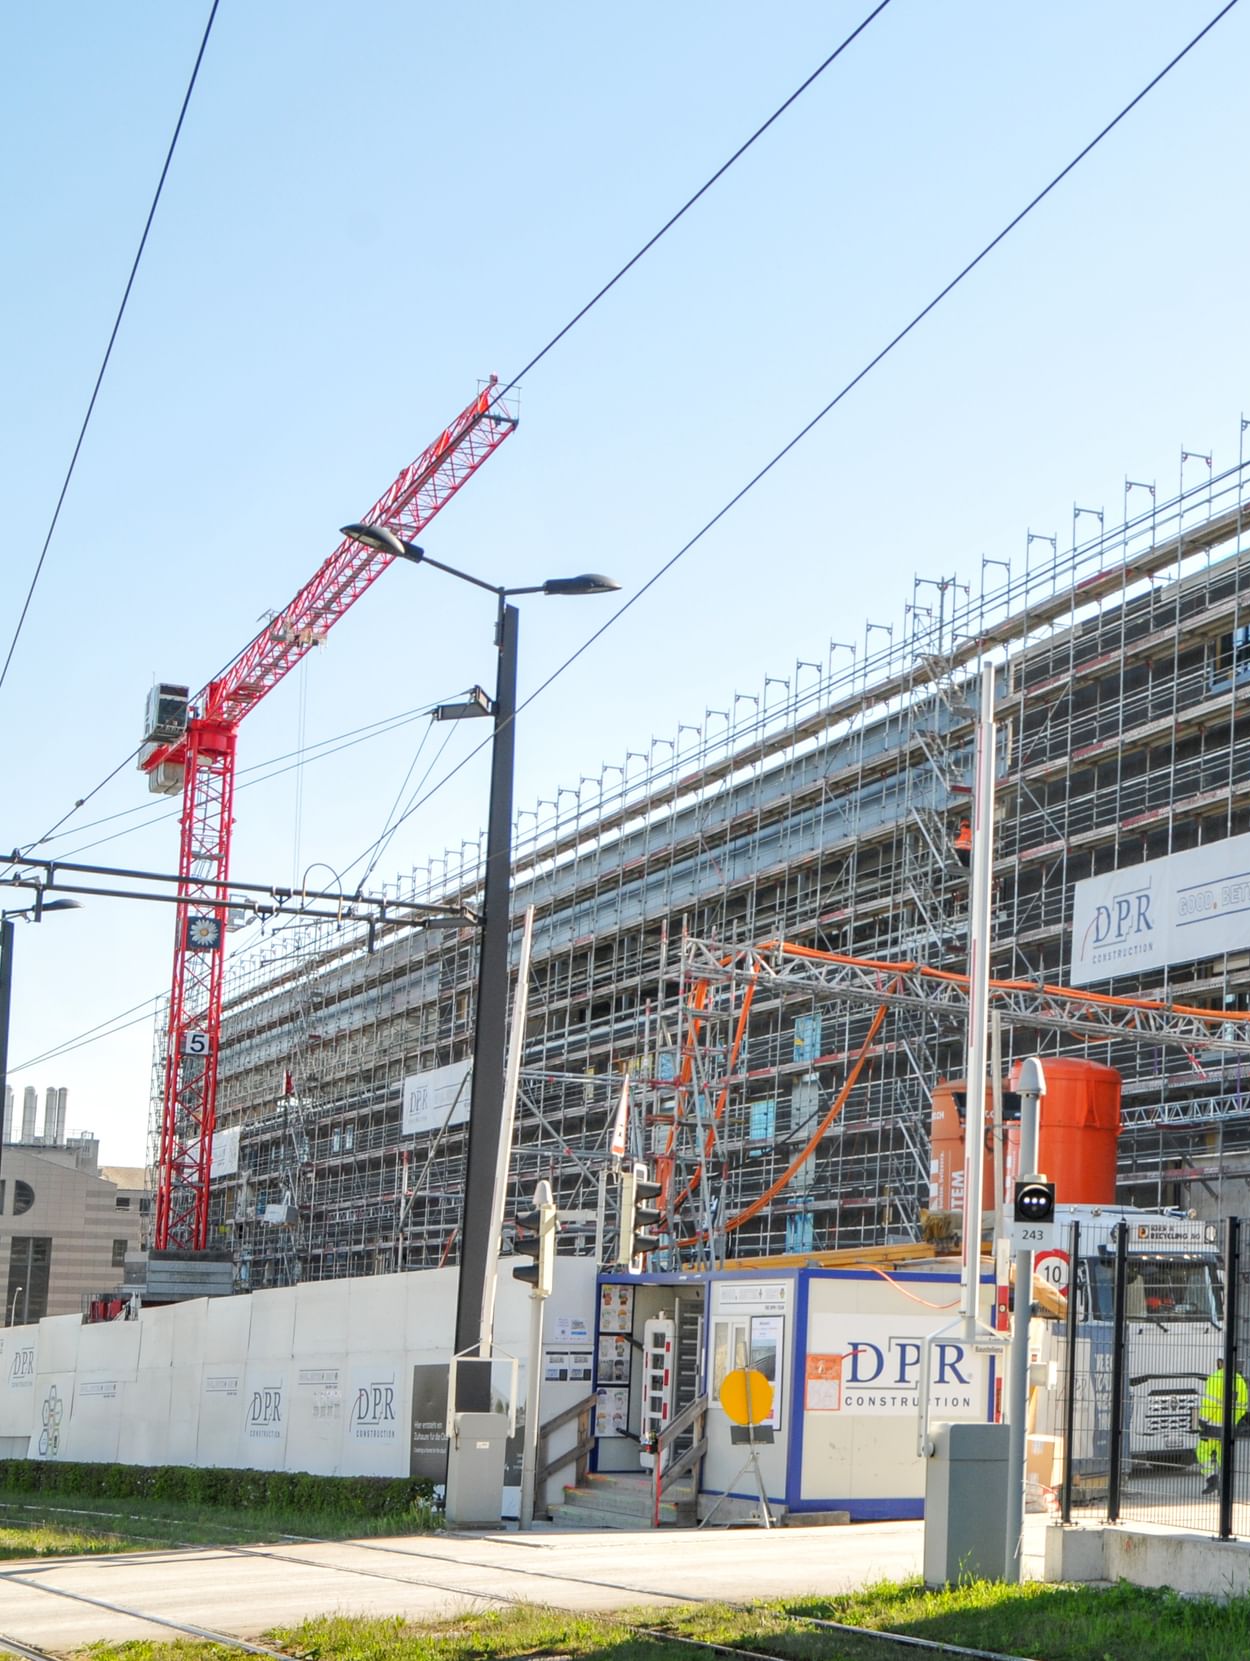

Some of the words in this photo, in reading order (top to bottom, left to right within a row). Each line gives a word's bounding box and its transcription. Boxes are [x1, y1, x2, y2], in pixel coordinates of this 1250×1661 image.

[1093, 894, 1152, 943] DPR
[1092, 943, 1153, 965] CONSTRUCTION
[190, 1034, 205, 1053] 5
[1022, 1229, 1044, 1241] 243
[1044, 1265, 1062, 1284] 10
[13, 1351, 34, 1375] DPR
[846, 1342, 970, 1384] DPR
[252, 1391, 281, 1422] DPR
[357, 1388, 395, 1420] DPR
[845, 1396, 970, 1407] CONSTRUTION
